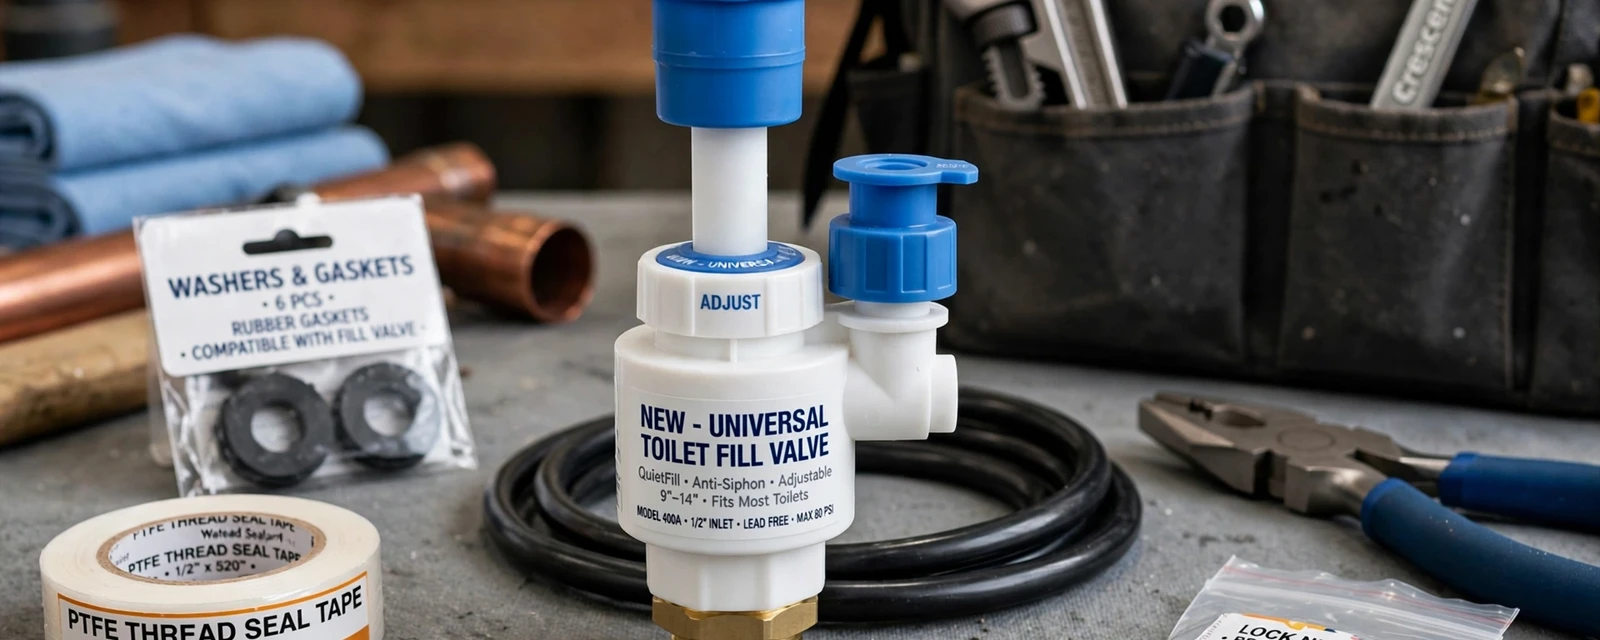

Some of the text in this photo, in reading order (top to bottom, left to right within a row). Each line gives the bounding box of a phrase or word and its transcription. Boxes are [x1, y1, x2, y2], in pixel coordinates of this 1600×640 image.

[168, 255, 415, 299] WASHERS & GASKETS
[275, 291, 323, 311] 6 PCS
[700, 294, 761, 310] ADJUST
[231, 307, 369, 337] RUBBER GASKETS
[192, 321, 417, 361] COMPATIBLE WITH FILL VALVE
[640, 403, 686, 434] NEW
[709, 405, 829, 437] UNIVERSAL
[640, 432, 829, 467] TOILET FILL VALVE
[638, 466, 832, 494] QuietFill Anti-Siphon Adjustable
[712, 495, 735, 508] Fits
[738, 493, 770, 508] Most
[772, 489, 809, 505] Toilets
[636, 505, 661, 522] MODEL
[662, 512, 682, 526] 400A
[708, 518, 734, 529] INLET
[743, 517, 766, 530] LEAD
[768, 514, 789, 527] FREE
[796, 511, 813, 523] MAX
[814, 508, 823, 519] 80
[128, 555, 160, 573] PTFE
[164, 544, 228, 563] THREAD
[233, 544, 269, 558] SEAL
[68, 585, 362, 640] PTFE THREAD SEAL TAPE
[1238, 624, 1297, 640] LOCK
